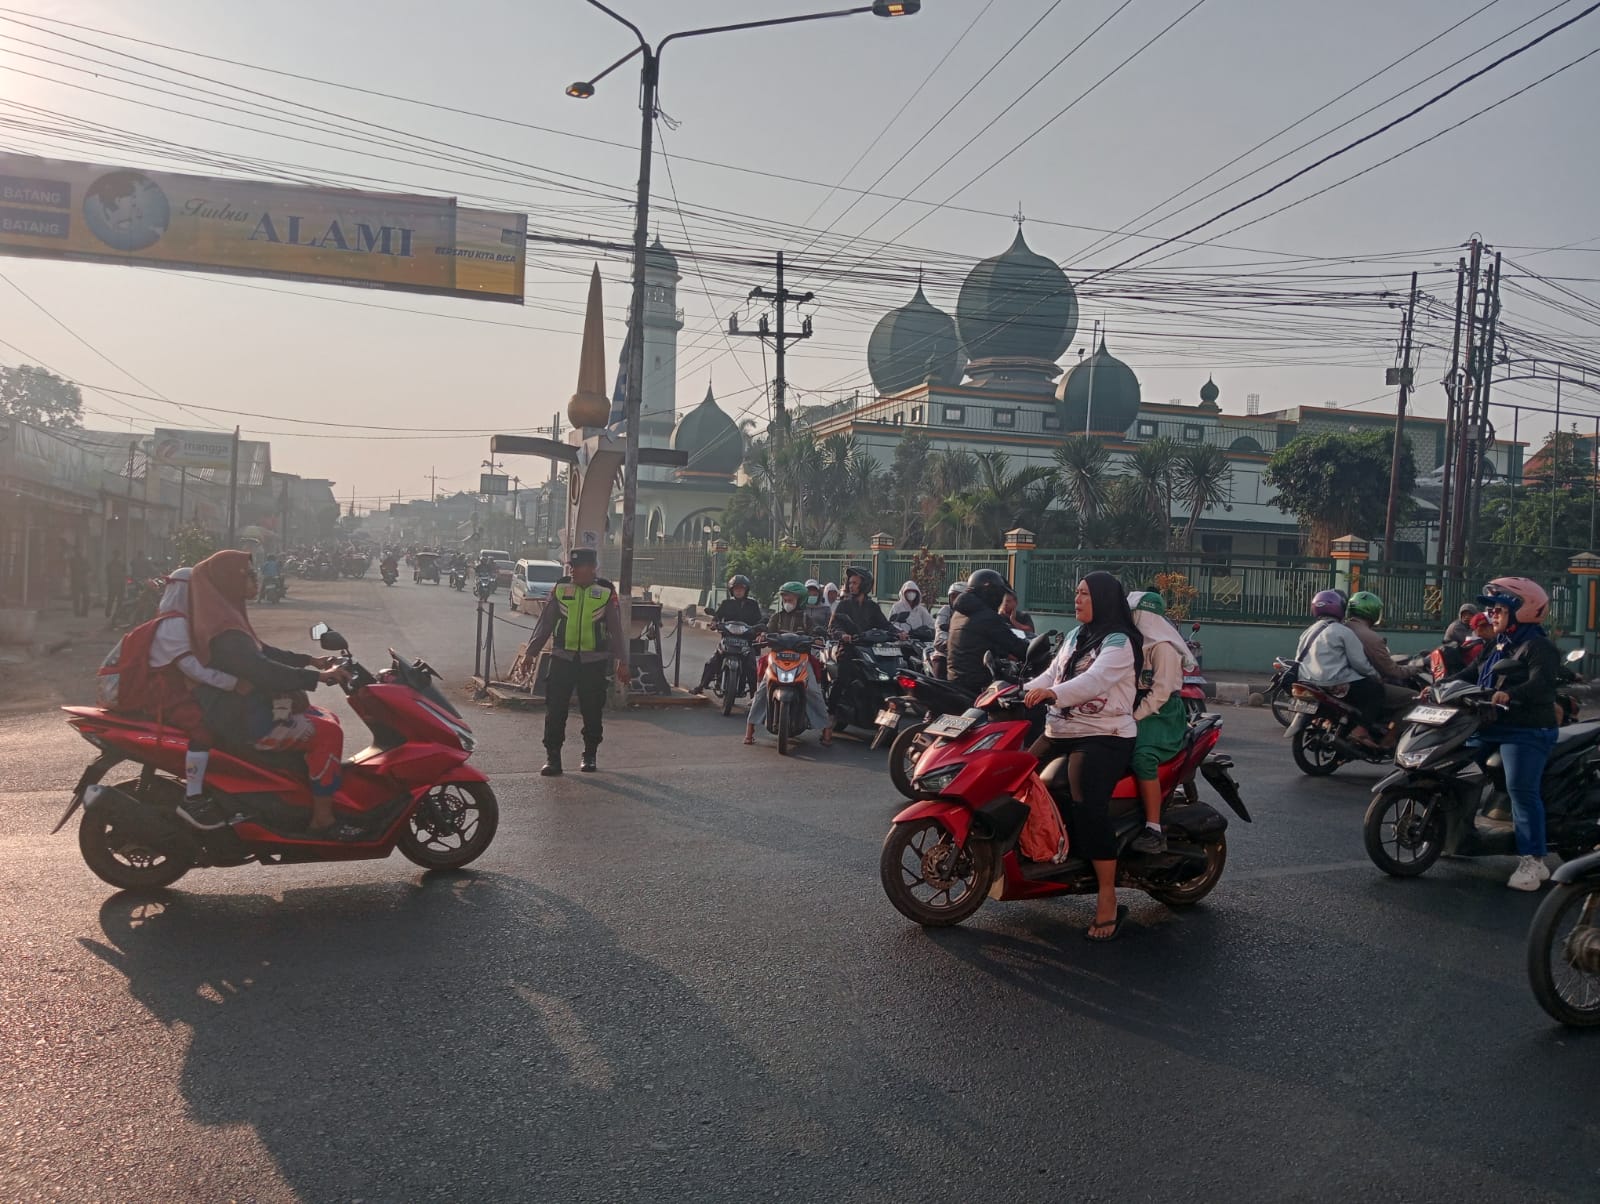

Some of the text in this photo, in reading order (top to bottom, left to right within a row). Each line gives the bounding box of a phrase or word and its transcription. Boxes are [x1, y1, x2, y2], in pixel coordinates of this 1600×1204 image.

[3, 185, 61, 204] BATANG
[2, 217, 60, 236] BATANG
[247, 212, 416, 258] ALAMI
[435, 247, 516, 262] BERSATU KITA BISA
